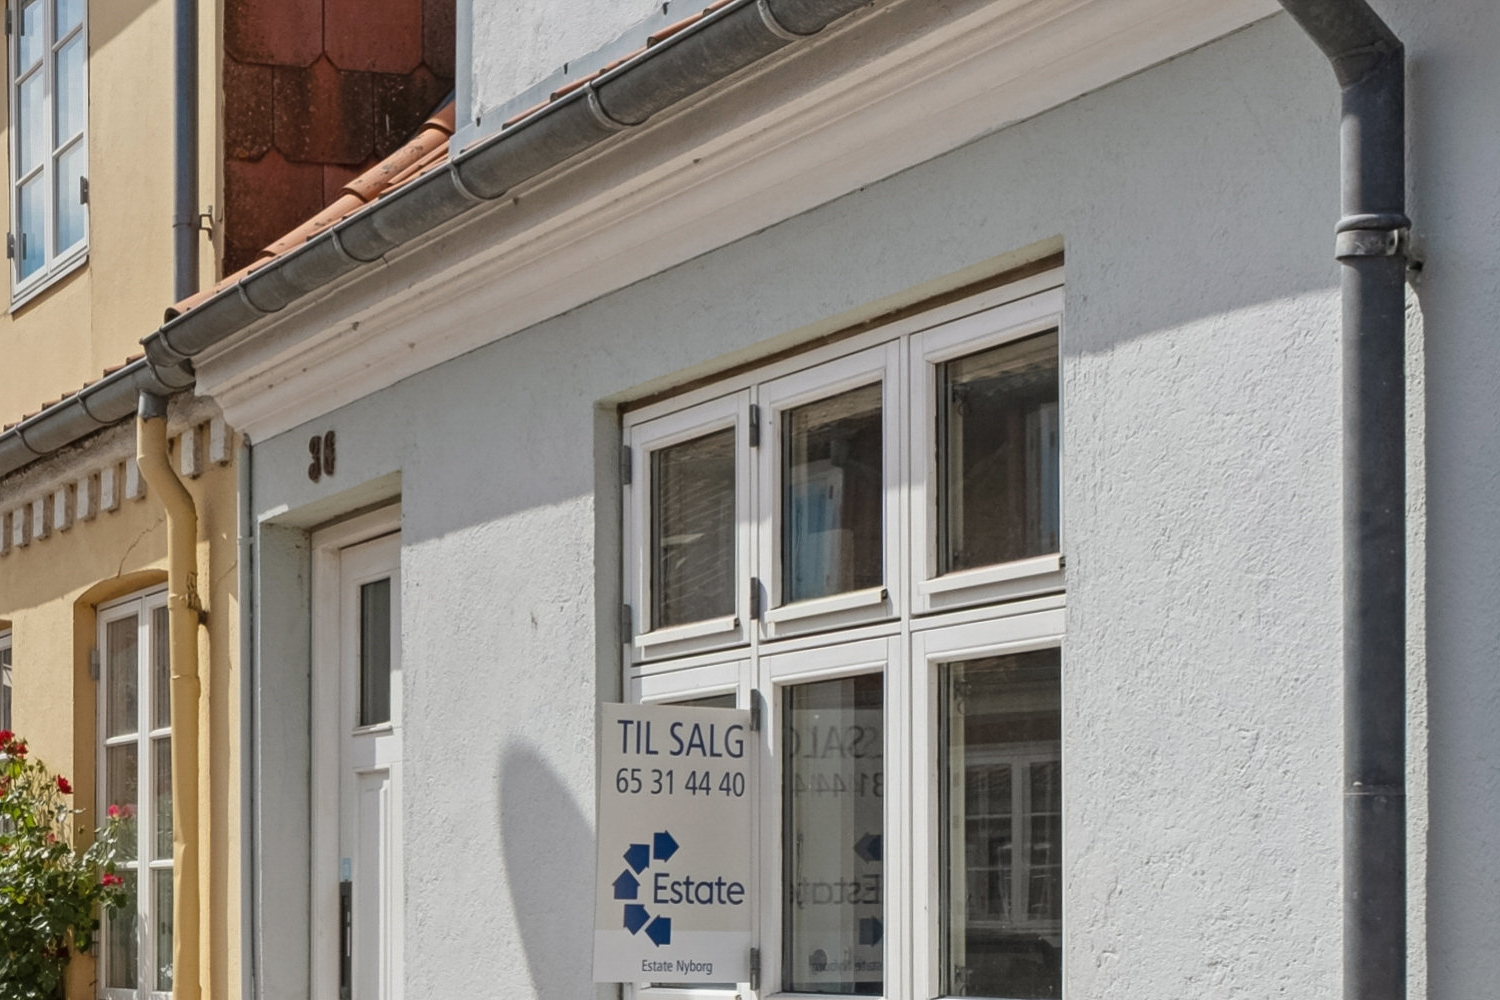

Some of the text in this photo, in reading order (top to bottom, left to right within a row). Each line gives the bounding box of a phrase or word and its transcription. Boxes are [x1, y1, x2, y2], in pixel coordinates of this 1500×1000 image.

[617, 719, 745, 758] TIL SALG
[616, 768, 745, 797] 65 31 44 40
[653, 873, 745, 905] Estate
[641, 959, 713, 976] Estate Nyborg
